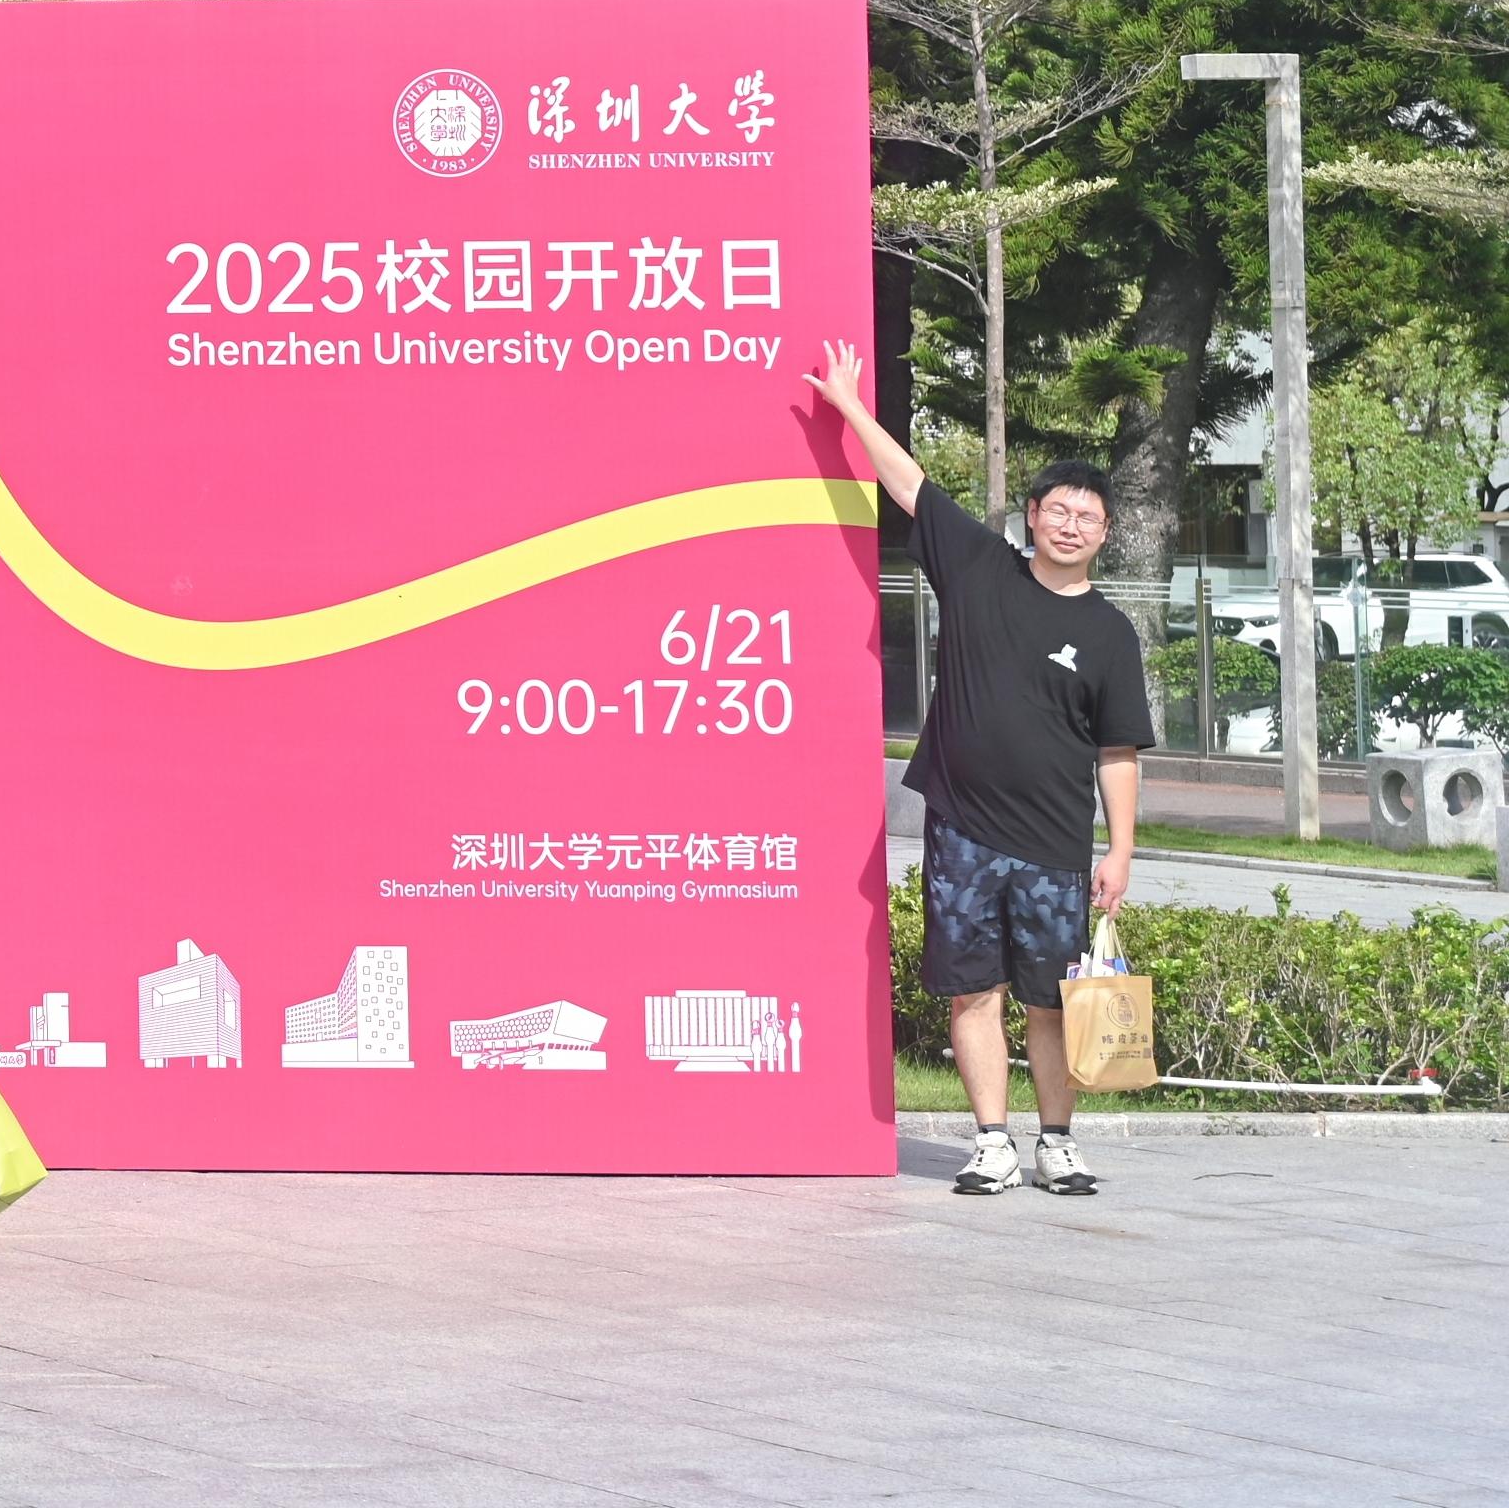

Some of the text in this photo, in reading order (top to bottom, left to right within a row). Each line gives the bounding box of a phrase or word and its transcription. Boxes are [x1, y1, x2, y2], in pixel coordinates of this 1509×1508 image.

[397, 74, 498, 153] SHENZHEN UNIVERSITY
[429, 158, 468, 172] 1983
[528, 151, 775, 169] SHENZHEN UNIVERSITY
[166, 236, 782, 316] 2025校园开放日
[168, 329, 782, 372] Shenzhen University Open Day
[660, 604, 794, 672] 6/21
[457, 678, 794, 736] 9:00-17:30
[451, 831, 799, 872] 深圳大学元平体育馆
[380, 879, 799, 903] Shenzhen University Yuanping Gymnasium
